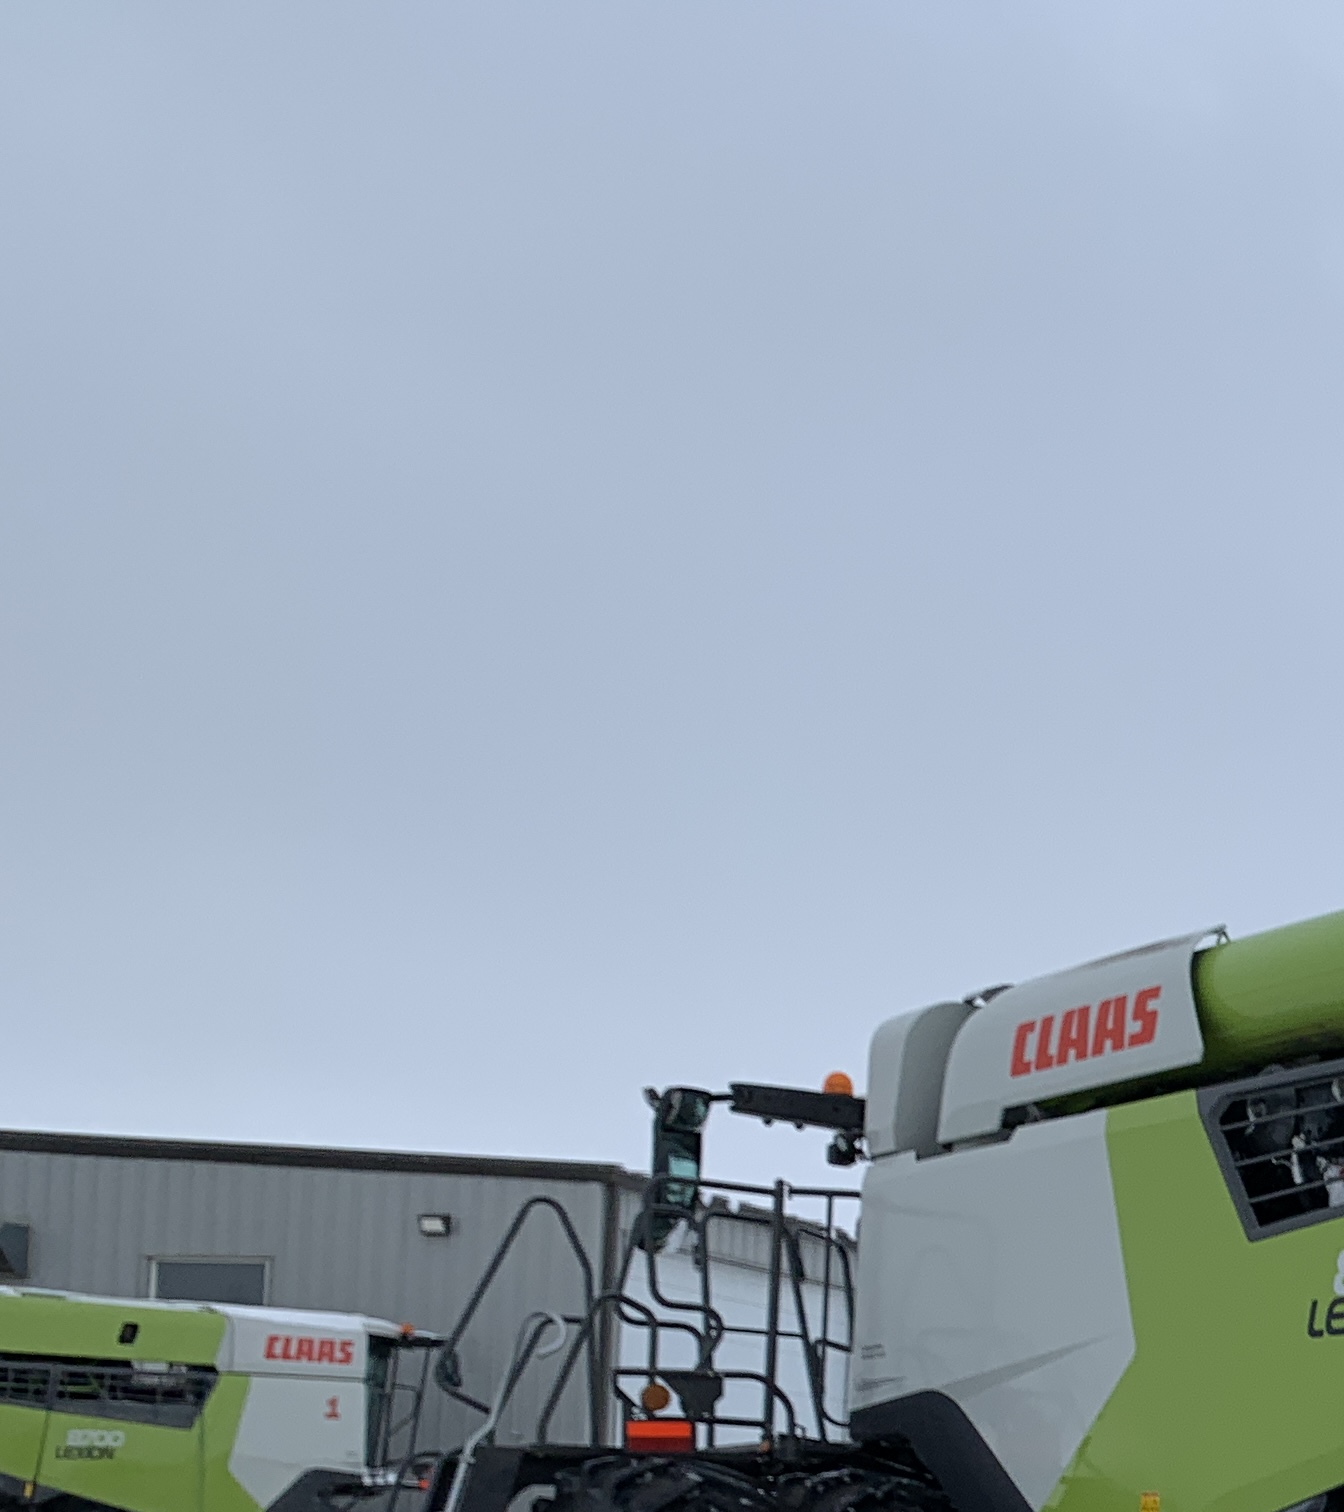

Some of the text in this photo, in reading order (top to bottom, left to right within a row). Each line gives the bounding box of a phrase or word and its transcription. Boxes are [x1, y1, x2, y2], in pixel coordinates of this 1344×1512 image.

[1010, 984, 1163, 1079] CLAAS
[264, 1335, 355, 1365] CLAAS
[323, 1396, 341, 1421] 1
